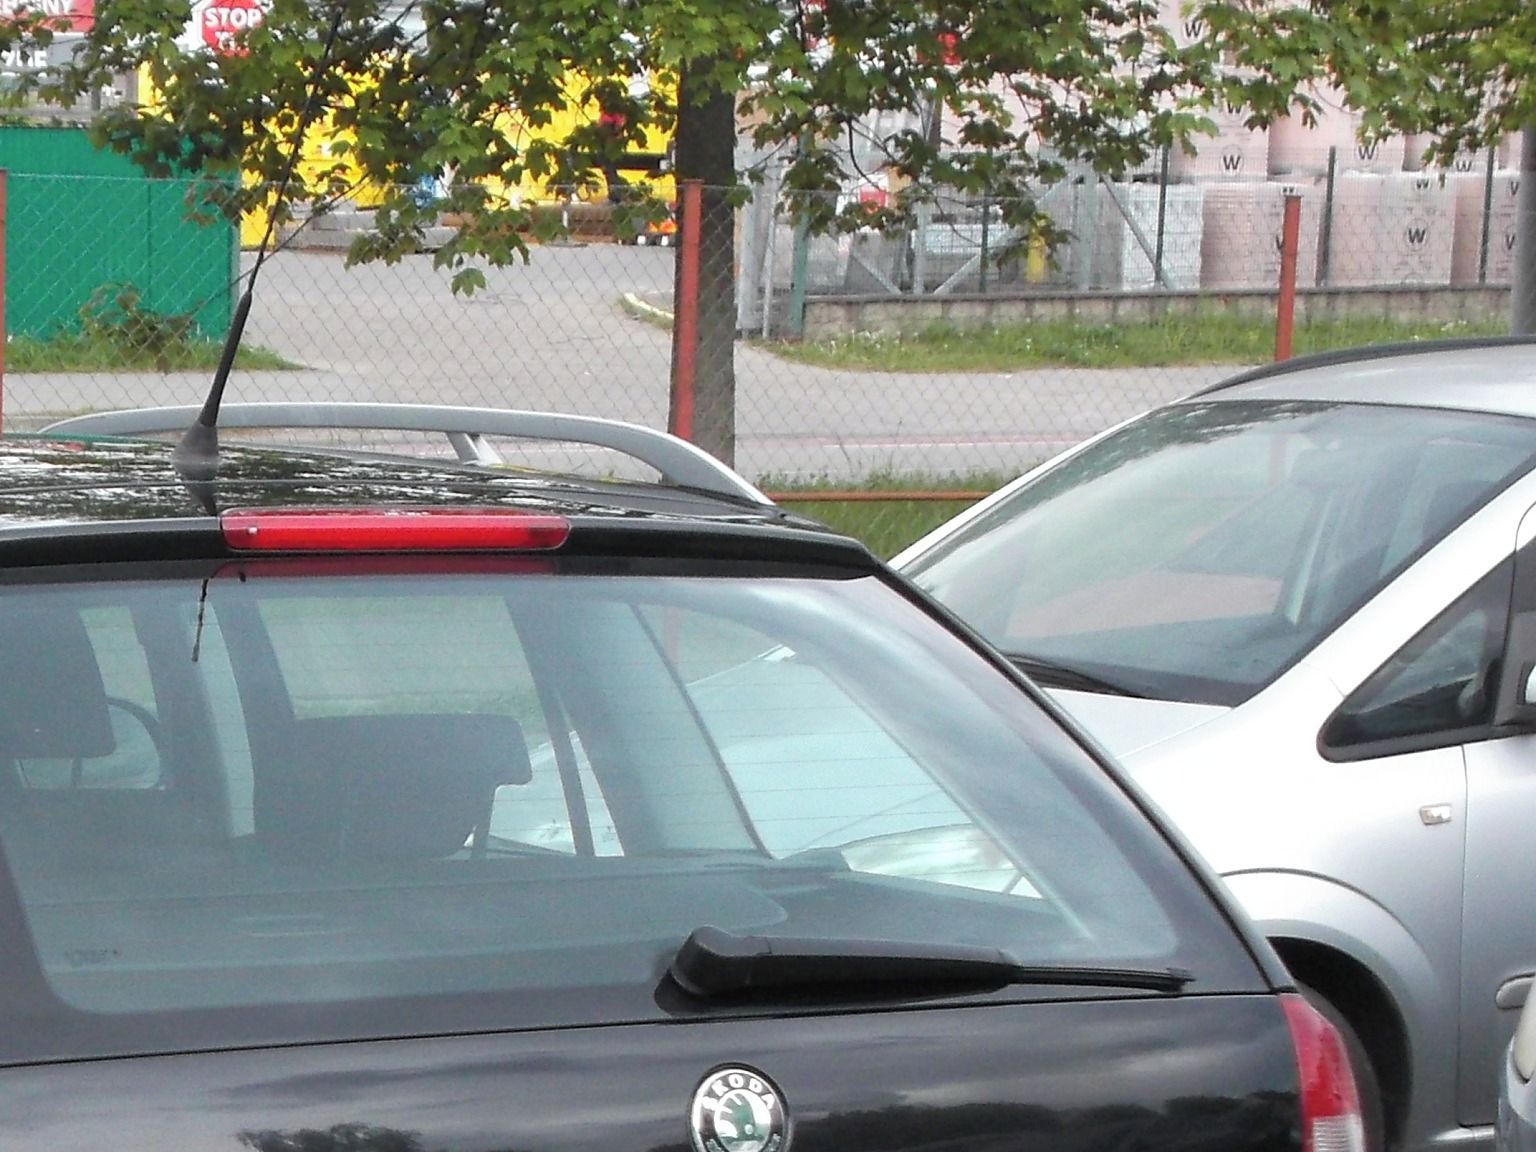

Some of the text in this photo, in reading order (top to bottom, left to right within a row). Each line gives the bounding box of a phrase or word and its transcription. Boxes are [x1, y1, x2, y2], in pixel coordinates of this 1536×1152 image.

[205, 7, 262, 29] STOP
[1184, 21, 1203, 38] W
[1358, 143, 1376, 160] W
[1222, 155, 1241, 170] W
[1455, 160, 1472, 172] W
[1408, 228, 1426, 244] W
